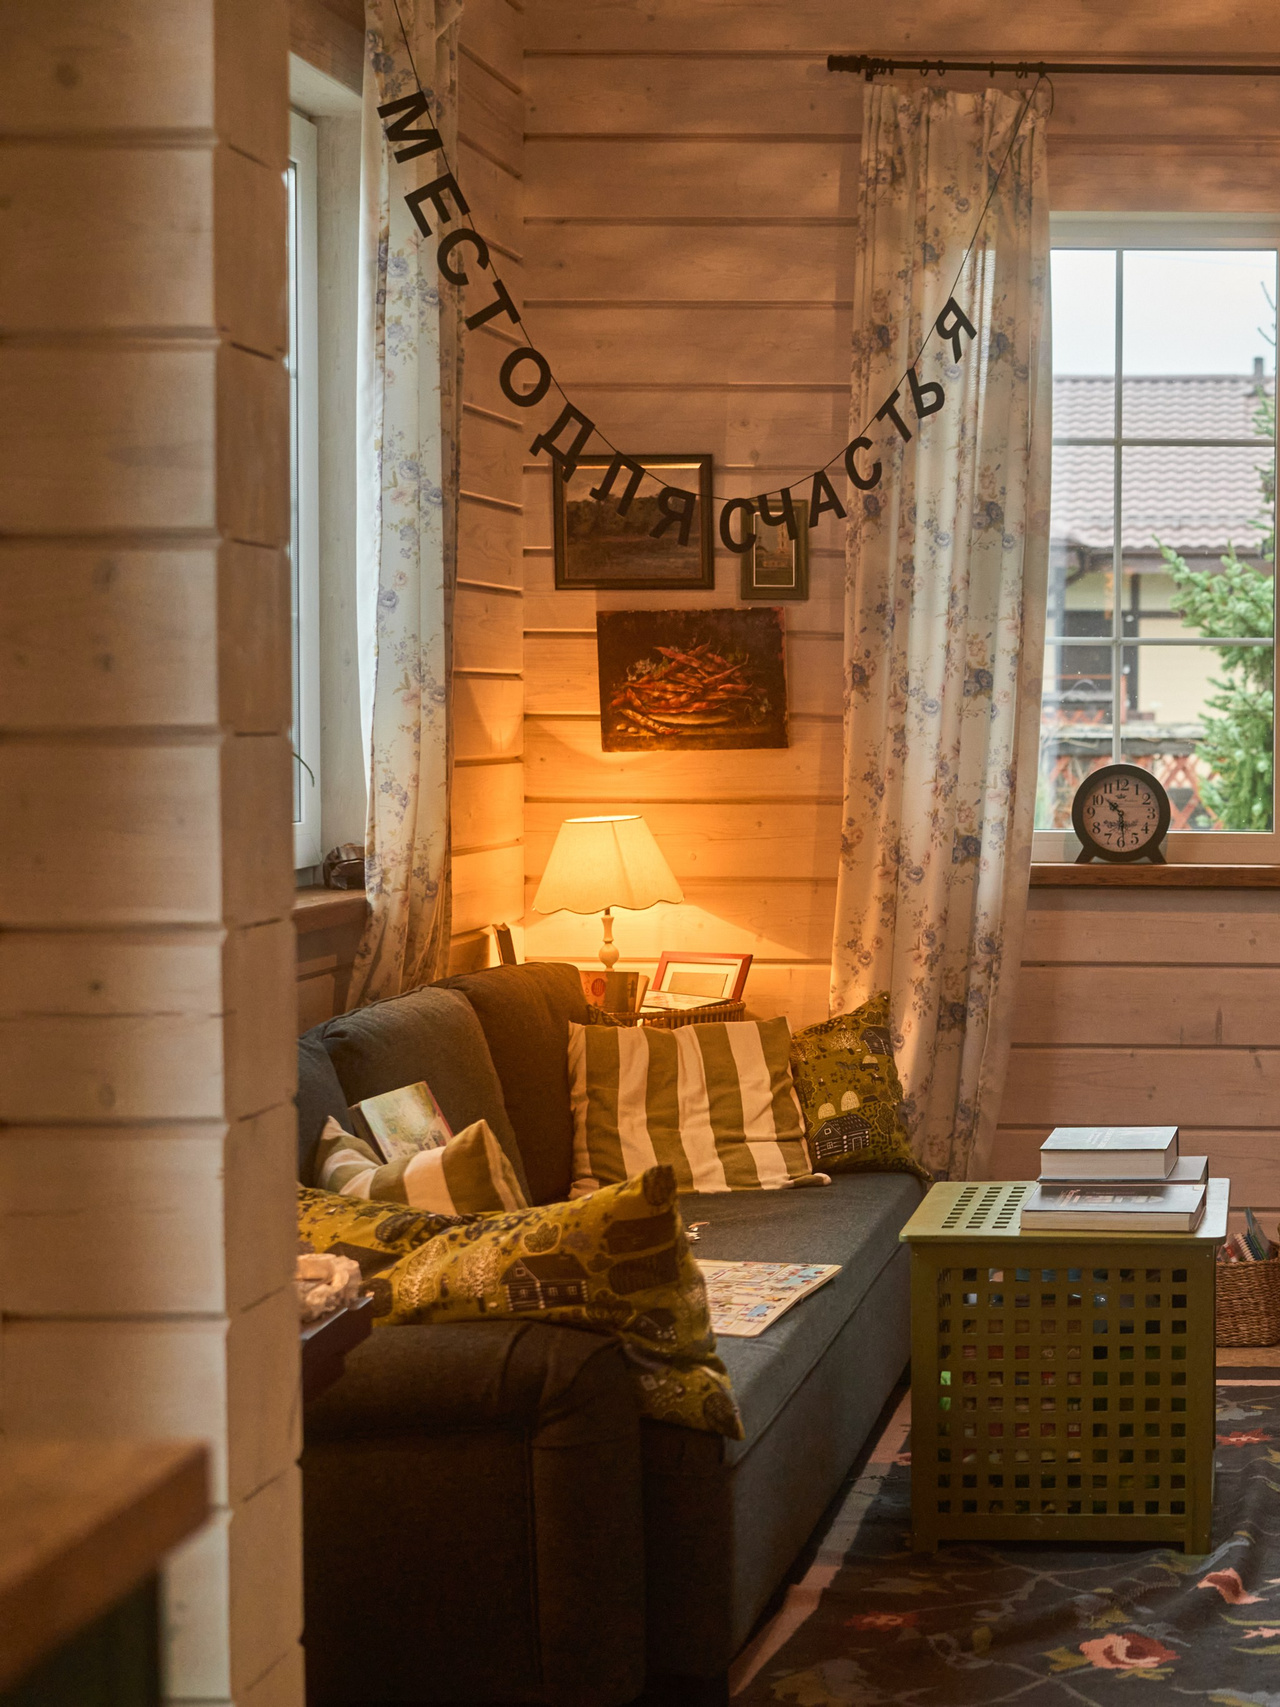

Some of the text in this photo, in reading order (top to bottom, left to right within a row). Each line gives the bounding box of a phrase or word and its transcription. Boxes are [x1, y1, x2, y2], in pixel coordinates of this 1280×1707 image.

[377, 91, 977, 554] МЕСТО ДЛЯ СЧАСТЬЯ
[1103, 783, 1112, 794] 11
[1116, 779, 1129, 791] 12
[1092, 794, 1104, 806] 10
[1142, 793, 1151, 805] 2
[1087, 807, 1095, 819] 9
[1147, 808, 1156, 819] 3
[1092, 822, 1101, 834] 8
[1141, 822, 1149, 834] 4
[1104, 833, 1112, 845] 7
[1117, 836, 1125, 848] 6
[1131, 833, 1139, 845] 5
